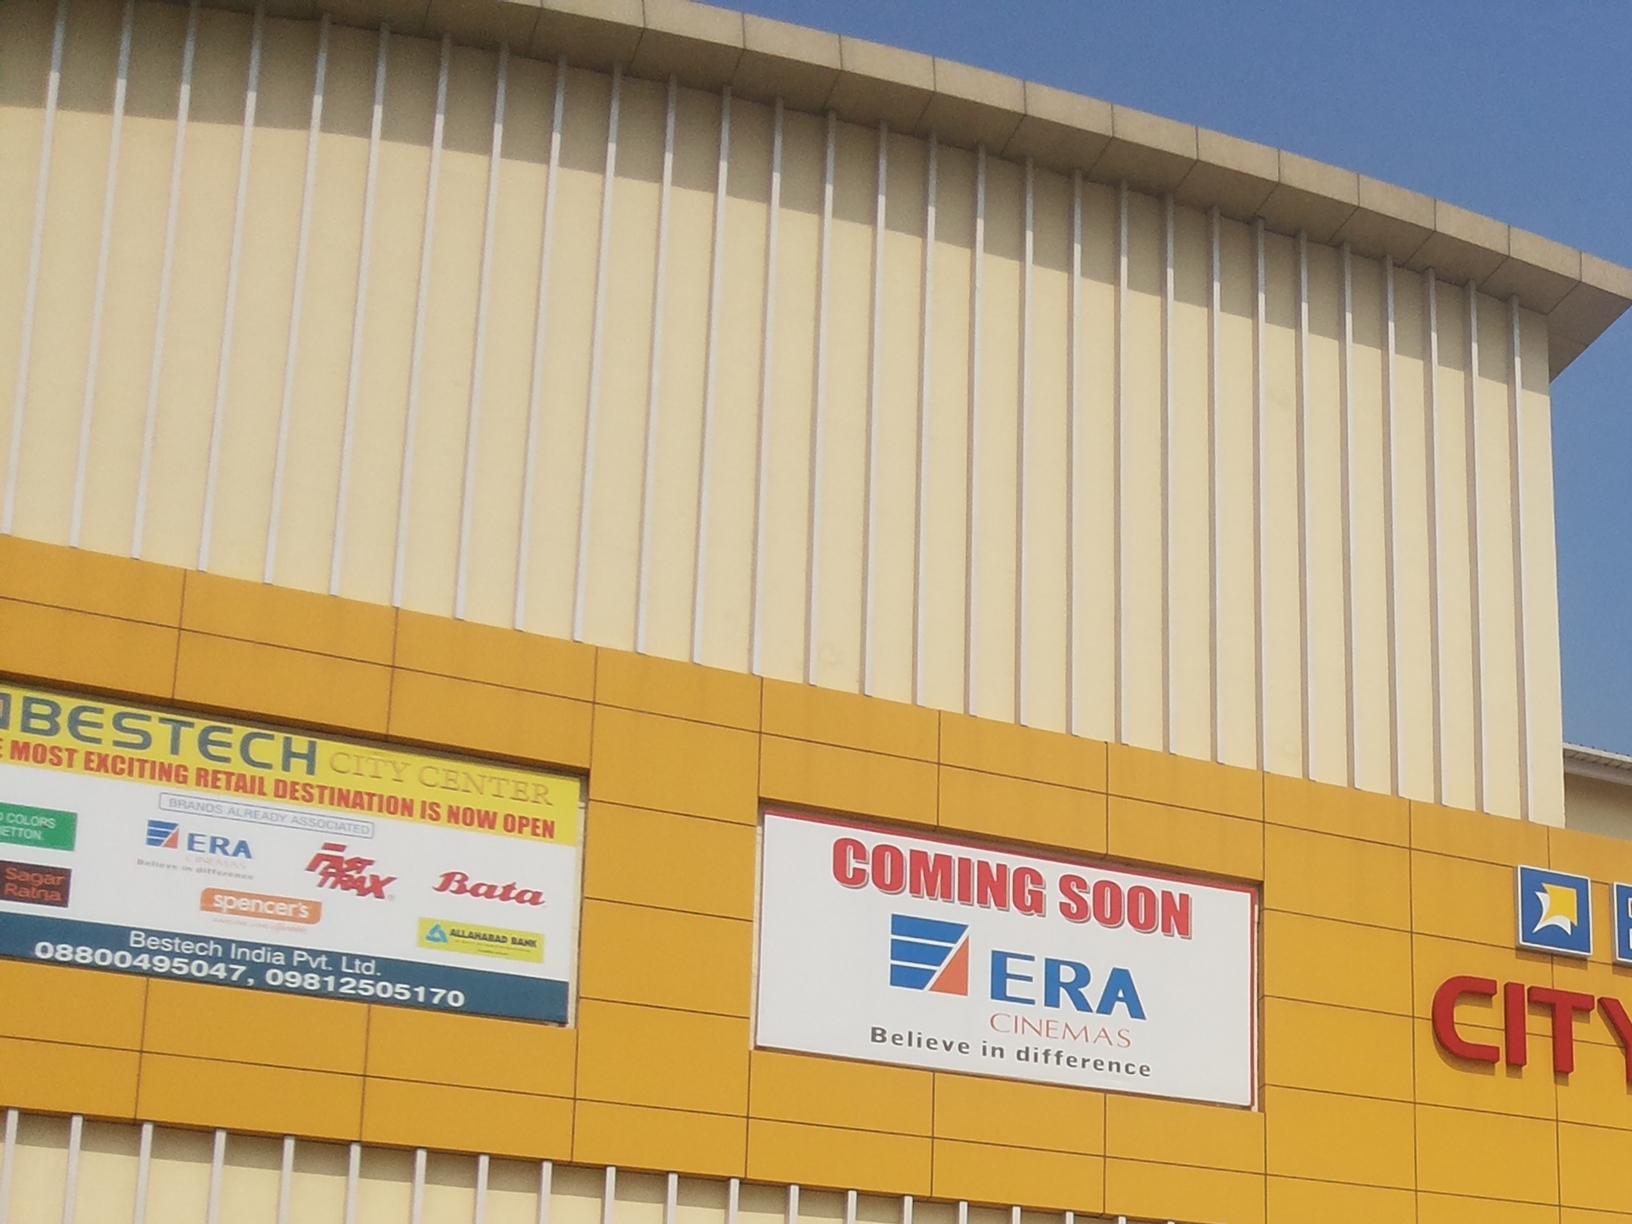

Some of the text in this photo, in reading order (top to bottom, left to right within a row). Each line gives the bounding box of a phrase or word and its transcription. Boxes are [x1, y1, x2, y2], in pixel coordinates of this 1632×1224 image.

[21, 695, 317, 776] BESTECH
[329, 751, 411, 783] CITY
[418, 766, 554, 806] CENTER
[10, 739, 78, 768] MOST
[84, 751, 189, 785] EXCITING
[195, 767, 267, 796] RETAIL
[273, 777, 414, 817] DESTINATION
[420, 800, 441, 821] IS
[447, 804, 498, 830] NOW
[503, 813, 556, 839] OPEN
[6, 812, 56, 829] COLORS
[168, 798, 371, 835] BRANDS ALREADY ASSOCIATED
[186, 832, 253, 860] ERA
[4, 883, 62, 902] Ratna
[6, 867, 65, 887] Sagar
[432, 870, 546, 907] Bata
[832, 836, 1193, 940] COMING SOON
[213, 892, 310, 919] spencer's
[129, 930, 382, 977] Bestech India Pvt. Ltd.
[34, 941, 465, 1008] 08800495047, 09812505170
[989, 947, 1147, 1021] ERA
[989, 1012, 1133, 1050] CINEMAS
[870, 1026, 1152, 1078] Believe in difference
